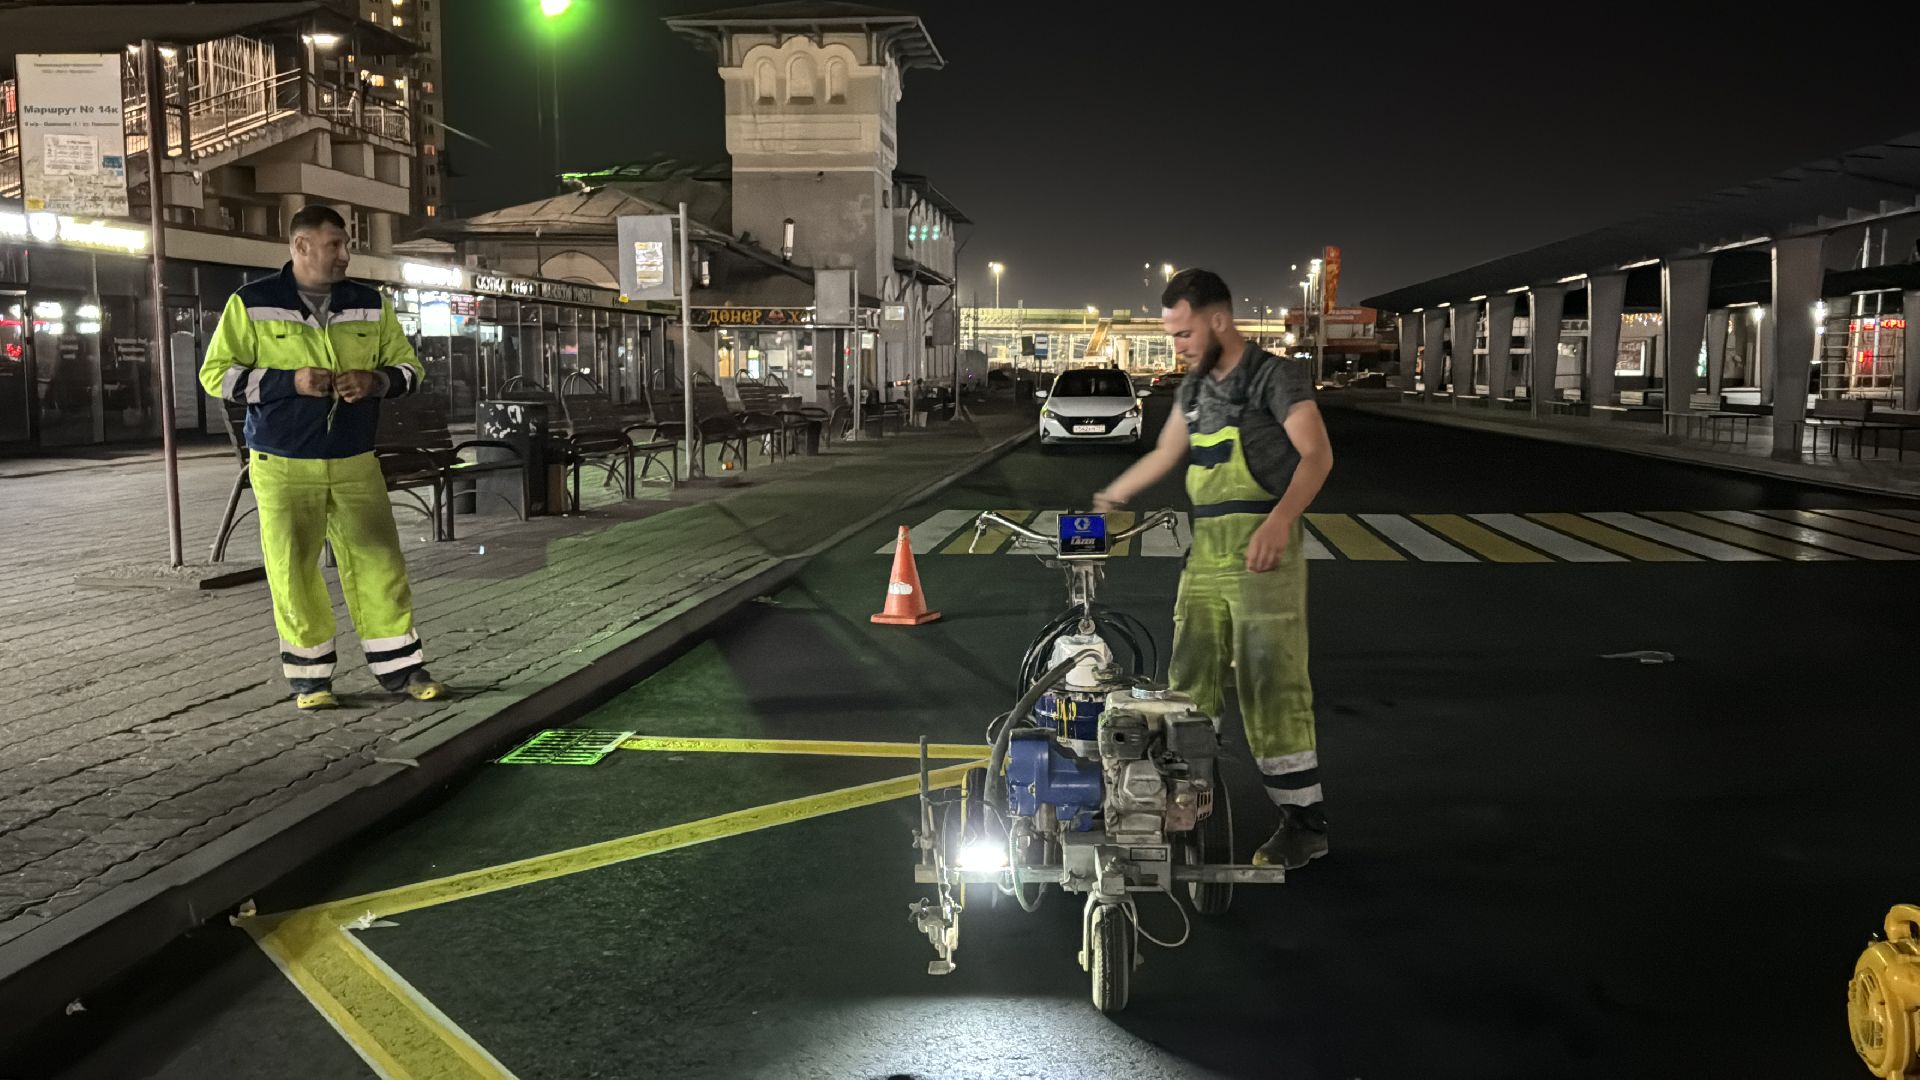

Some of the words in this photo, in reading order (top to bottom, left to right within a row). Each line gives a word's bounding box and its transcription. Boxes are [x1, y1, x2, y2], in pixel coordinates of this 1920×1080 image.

[24, 105, 76, 115] Маршрут
[80, 105, 95, 114] №
[98, 105, 119, 114] 14к
